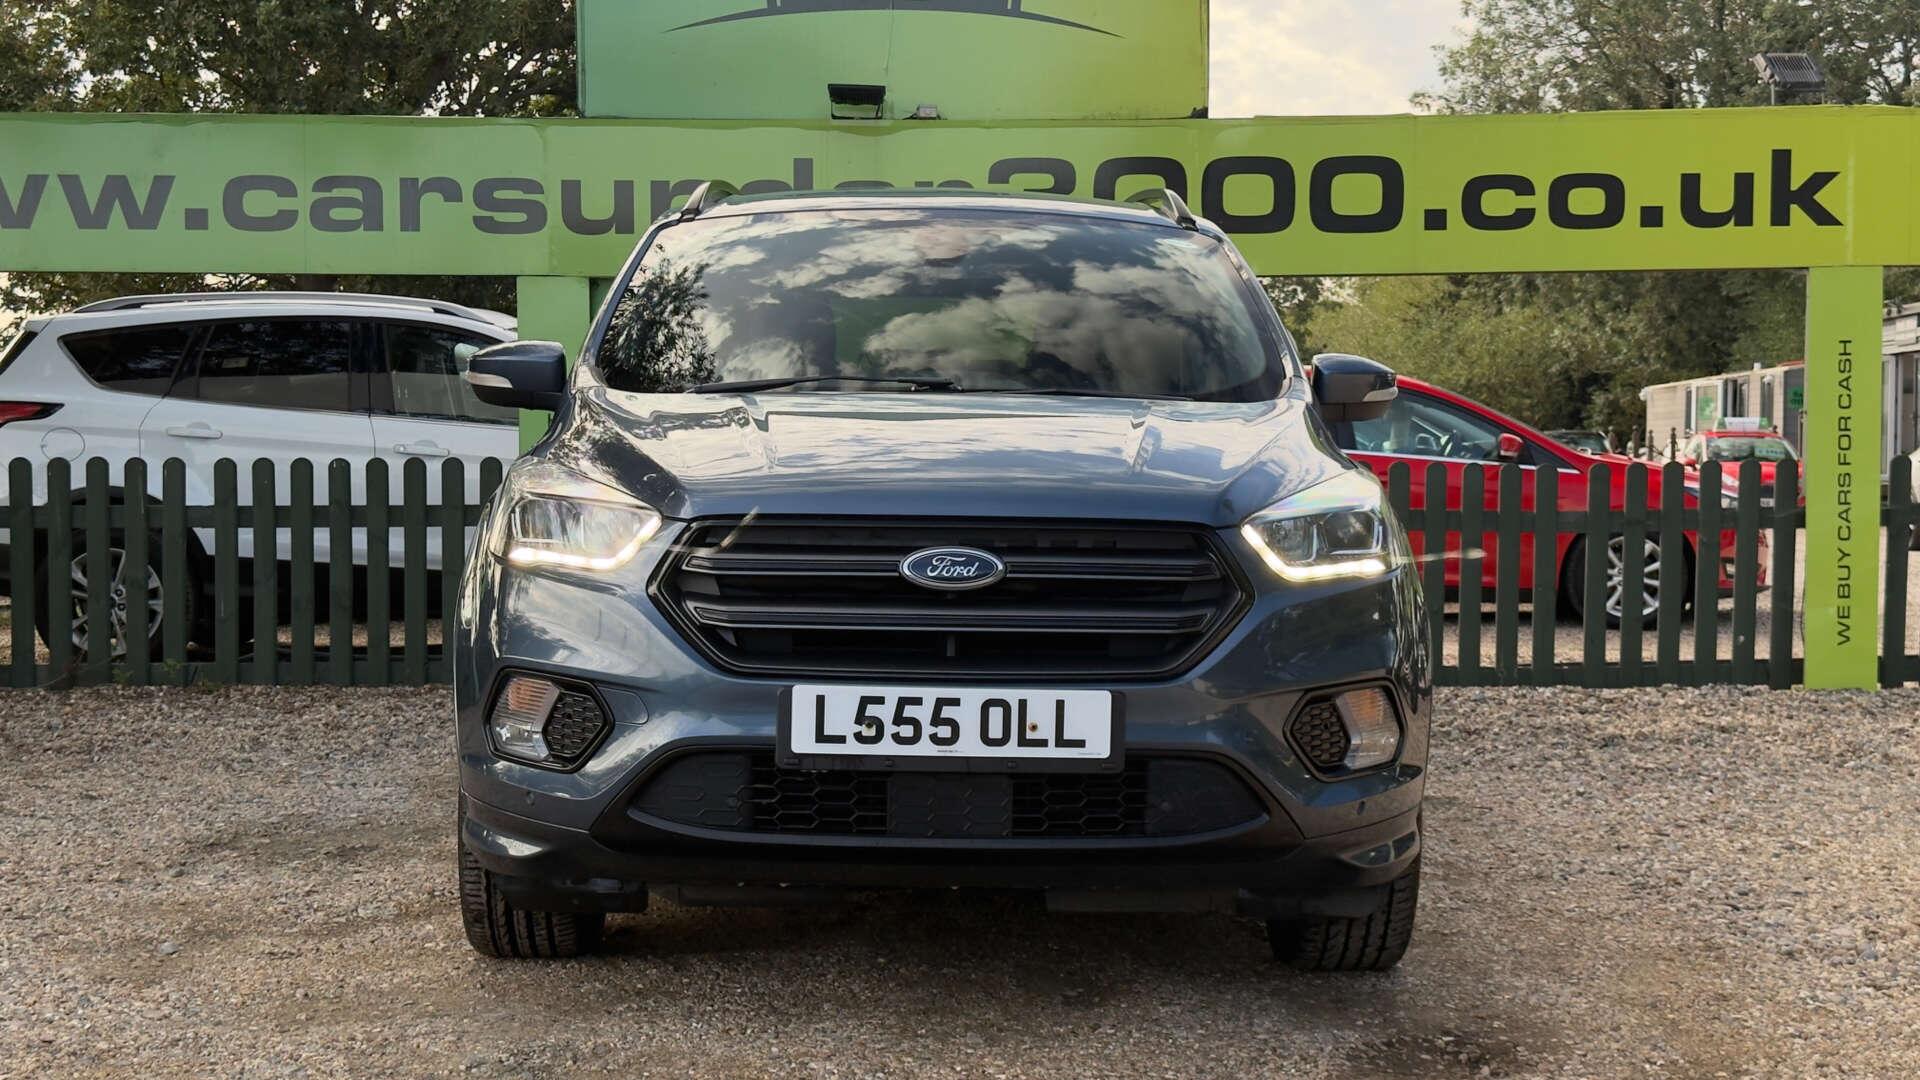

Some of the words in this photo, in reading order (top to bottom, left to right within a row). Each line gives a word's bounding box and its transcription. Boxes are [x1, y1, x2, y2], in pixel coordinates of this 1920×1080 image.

[1837, 339, 1853, 410] CASH
[1837, 416, 1852, 466] FOR
[1837, 472, 1852, 542] CARS
[926, 555, 980, 577] Ford
[1837, 547, 1851, 600] BUY
[1836, 605, 1851, 646] WE
[814, 694, 961, 747] L555
[979, 697, 1086, 749] OLL
